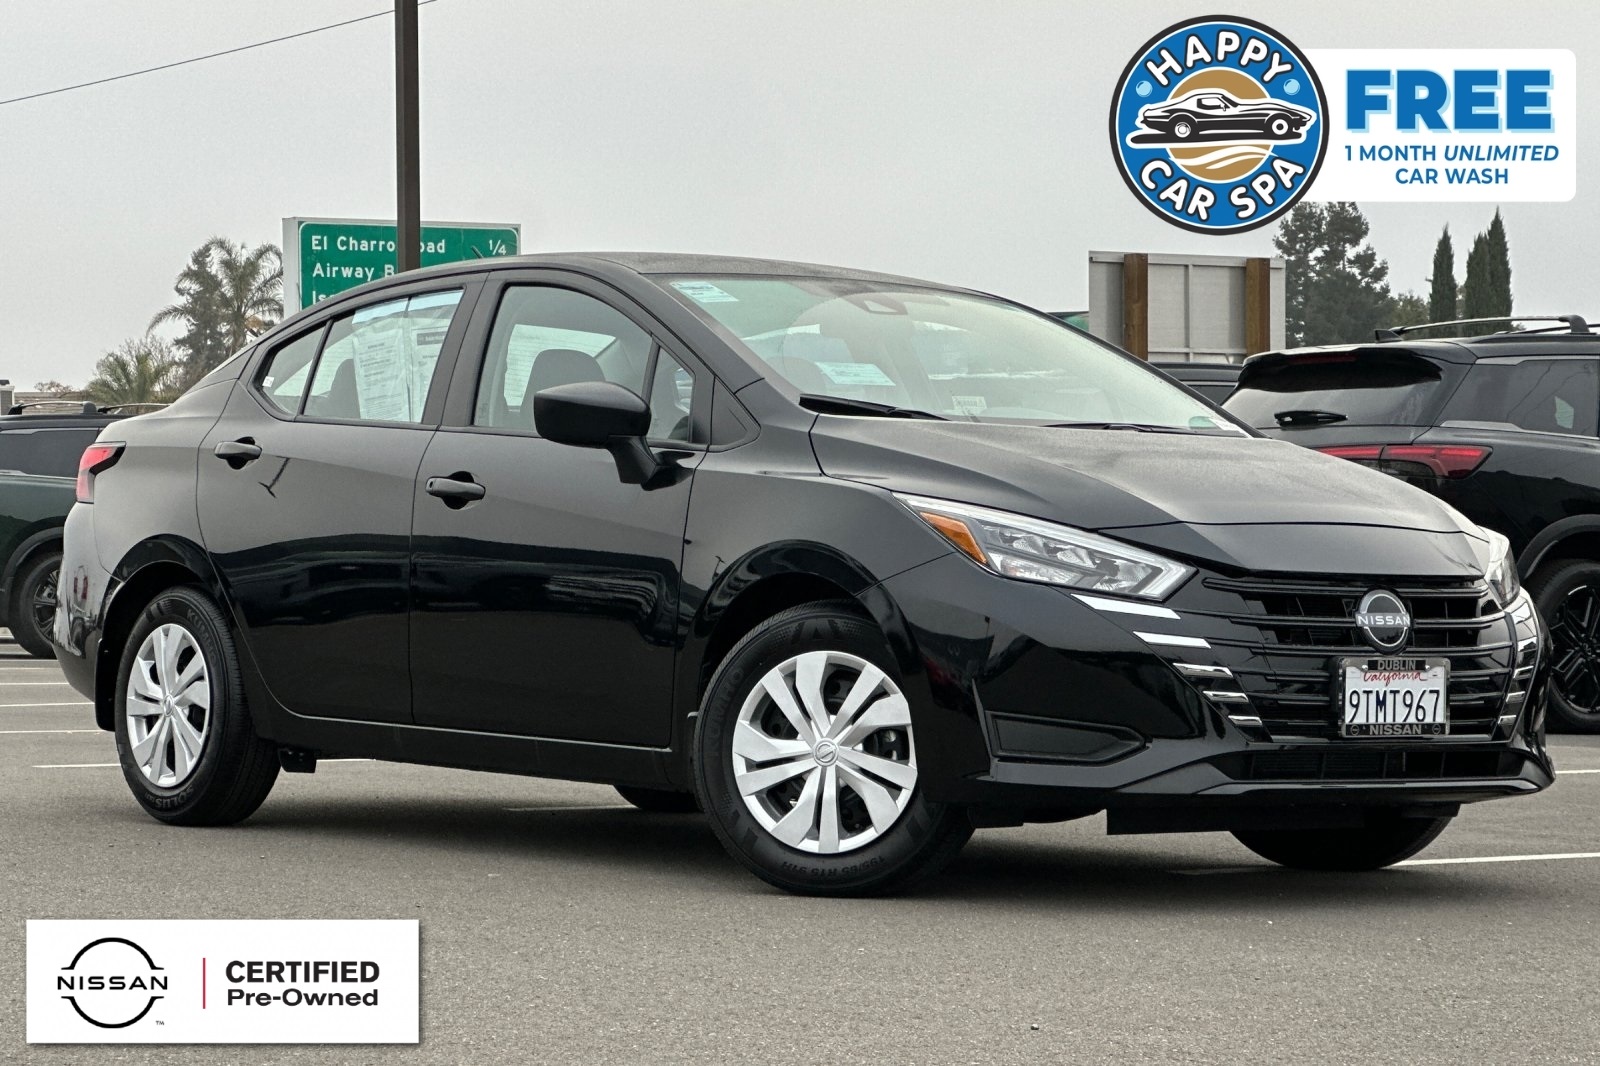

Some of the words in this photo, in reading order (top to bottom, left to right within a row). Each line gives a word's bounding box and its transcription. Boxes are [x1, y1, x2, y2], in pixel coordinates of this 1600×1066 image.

[311, 235, 328, 251] El
[336, 236, 395, 252] Charro
[312, 263, 374, 282] Airway
[1357, 615, 1410, 626] NISSAN
[1377, 659, 1416, 671] DUBLIN
[1363, 671, 1428, 687] California
[1348, 689, 1440, 723] 9TMT967
[1370, 724, 1422, 736] NISSAN
